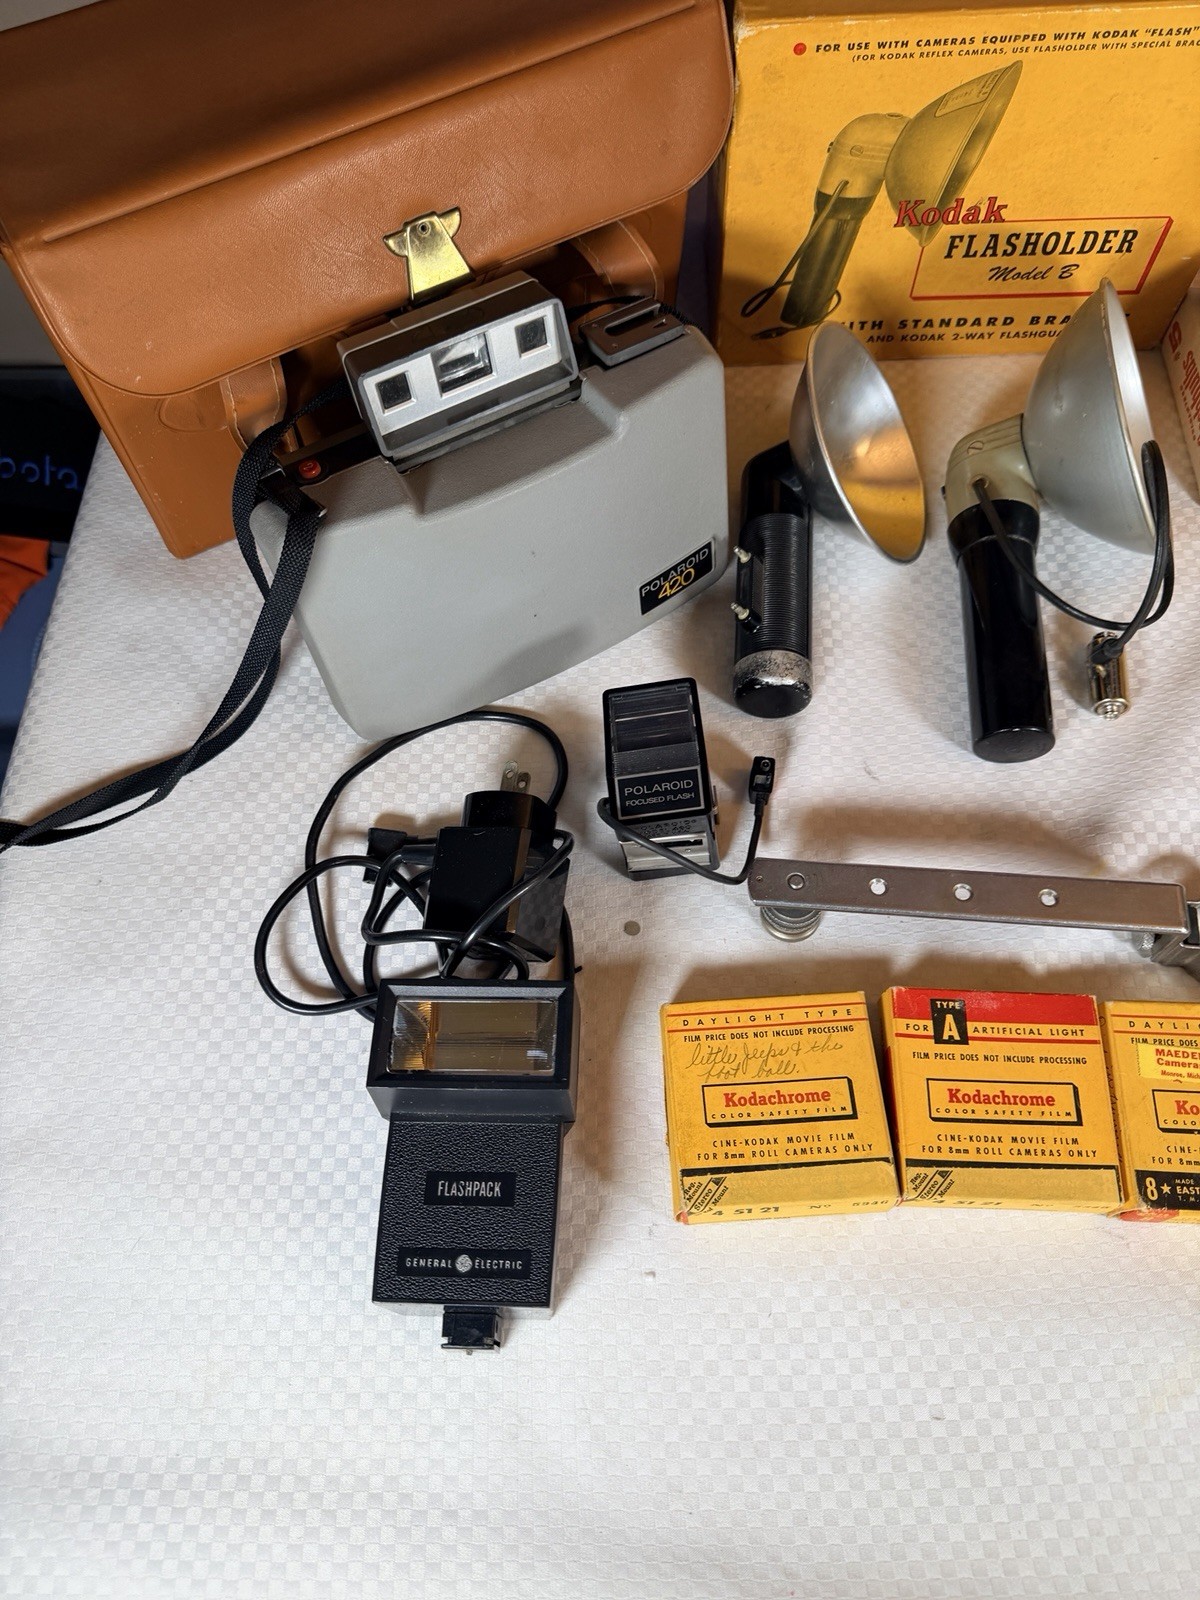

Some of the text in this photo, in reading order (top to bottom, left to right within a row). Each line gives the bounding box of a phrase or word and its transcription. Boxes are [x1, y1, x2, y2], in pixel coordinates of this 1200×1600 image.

[815, 43, 841, 53] FOR
[847, 42, 870, 51] USE
[877, 40, 909, 50] WITH
[916, 36, 976, 47] CAMERAS
[982, 33, 1047, 44] EQUIPPED
[1053, 32, 1086, 41] WITH
[1092, 29, 1139, 40] KODAK
[852, 54, 876, 63] (FOR
[880, 51, 915, 60] KODAK
[919, 50, 954, 58] REFLEX
[958, 46, 1007, 57] CAMERAS,
[1012, 46, 1030, 54] USE
[1033, 43, 1097, 53] FLASHOLDER
[1101, 42, 1127, 50] WITH
[1131, 40, 1171, 49] SPECIAL
[893, 196, 1008, 228] Kodak
[944, 229, 1139, 260] FLASHOLDER
[987, 263, 1080, 282] Model B
[842, 320, 884, 331] ITH
[897, 316, 1015, 329] STANDARD
[866, 334, 895, 343] AND
[900, 332, 946, 342] KODAK
[952, 332, 995, 341] 2-WAY
[641, 548, 709, 597] POLAROID
[658, 567, 695, 599] 420
[624, 779, 694, 796] POLAROID
[626, 792, 695, 807] FOCUSED FLASH
[936, 1000, 962, 1010] TYPE
[682, 1008, 852, 1027] DAYLIGHT TYPE
[1129, 1020, 1200, 1030] DAYLI
[683, 1025, 854, 1043] FILM PRICE DOES NOT INCLUDE PROCESSING
[905, 1013, 1085, 1041] FOR A ARTIFICIAL LIGHT
[1130, 1037, 1198, 1047] FILM PRICE DOES
[685, 1043, 738, 1069] little
[912, 1051, 1087, 1065] FILM PRICE DOES NOT INCLUDE PROCESSING
[1155, 1048, 1200, 1060] MAEDE
[1156, 1058, 1200, 1069] Camera
[724, 1089, 832, 1108] Kodachrome
[947, 1088, 1056, 1107] Kodachrome
[711, 1112, 752, 1120] COLOR
[760, 1108, 807, 1117] SAFETY
[935, 1107, 976, 1115] COLOR
[712, 1132, 855, 1148] CINE-KODAK MOVIE FILM
[937, 1134, 1079, 1146] CINE-KODAK MOVIE FILM
[697, 1143, 874, 1161] FOR 8mm ROLL CAMERAS ONLY
[922, 1145, 1097, 1158] FOR 8mm ROLL CAMERAS ONLY
[1166, 1145, 1200, 1154] CINE-
[1151, 1156, 1172, 1165] FOR
[437, 1180, 502, 1197] FLASHPACK
[912, 1172, 929, 1192] Mount
[937, 1179, 955, 1198] Mount
[1145, 1176, 1158, 1201] 8
[686, 1181, 703, 1203] Mount
[693, 1188, 713, 1211] Stereo
[711, 1185, 729, 1206] Mount
[405, 1258, 453, 1268] GENERAL
[474, 1258, 523, 1270] ELECTRIC
